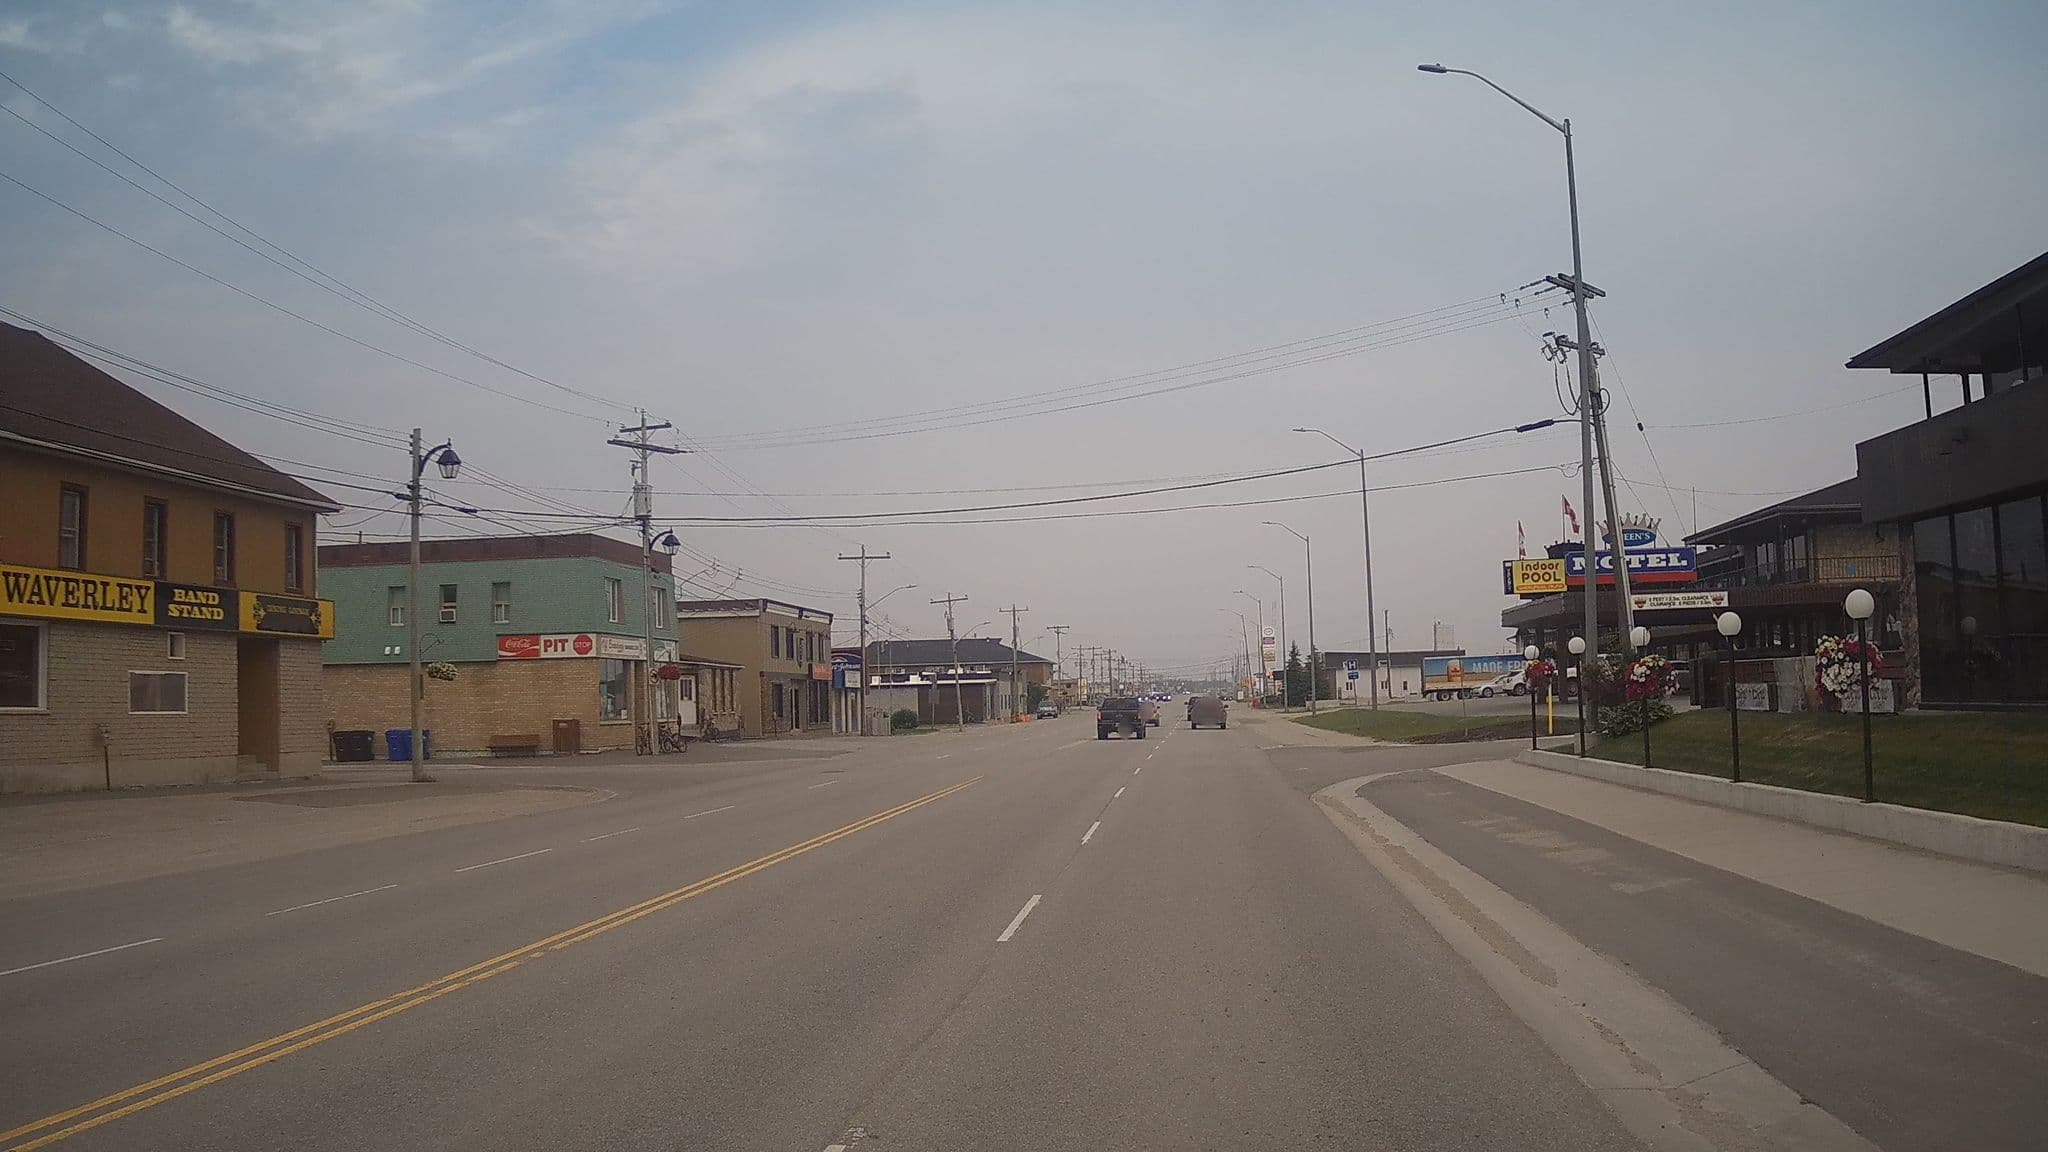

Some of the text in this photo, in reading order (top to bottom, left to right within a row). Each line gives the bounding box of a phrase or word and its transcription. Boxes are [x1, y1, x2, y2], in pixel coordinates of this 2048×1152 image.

[1572, 553, 1688, 571] MOTEL
[1521, 571, 1561, 583] POOL
[2, 571, 151, 614] WAVERLEY
[173, 588, 220, 604] BAND
[168, 603, 225, 620] STAND
[543, 638, 569, 653] PIT
[574, 640, 592, 649] STOP
[1472, 661, 1503, 673] MADE
